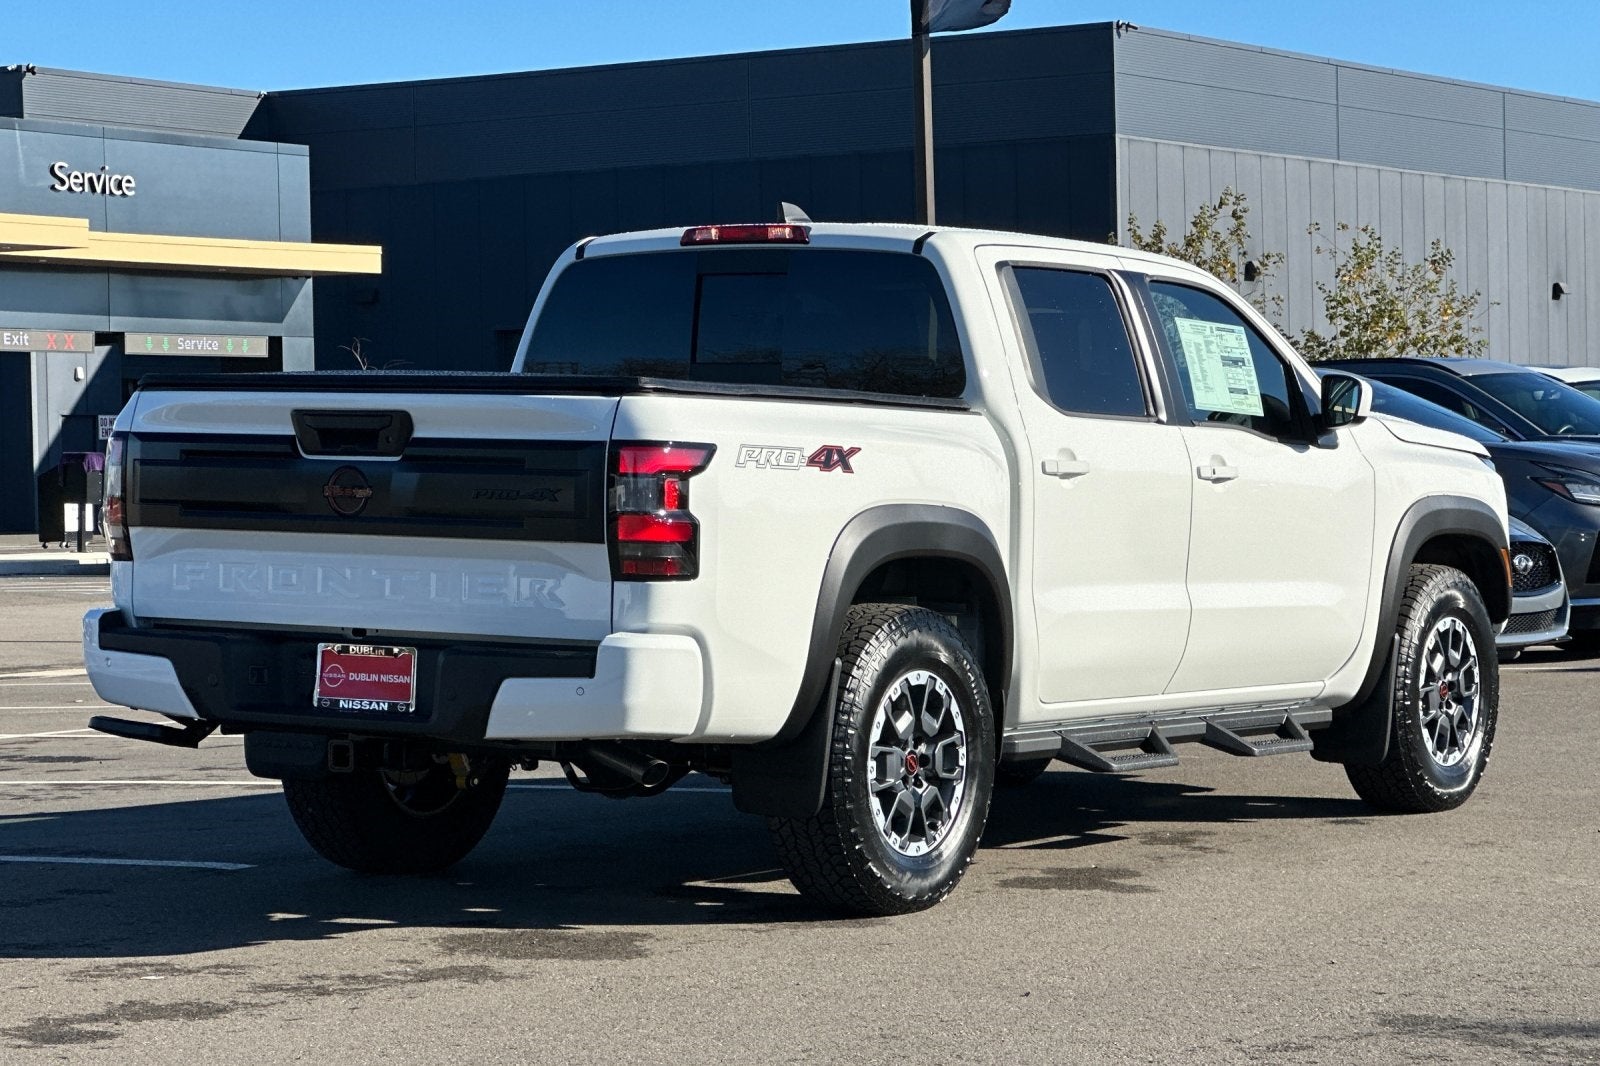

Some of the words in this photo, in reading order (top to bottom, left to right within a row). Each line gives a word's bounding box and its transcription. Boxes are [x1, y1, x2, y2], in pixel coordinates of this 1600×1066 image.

[53, 161, 136, 196] Service
[3, 332, 29, 346] Exit
[177, 337, 219, 350] Service
[172, 560, 567, 609] FRONTIER
[349, 645, 385, 656] DUBLIN
[348, 672, 379, 682] DUBLIN
[380, 675, 411, 684] NISSAN
[339, 699, 389, 711] NISSAN
